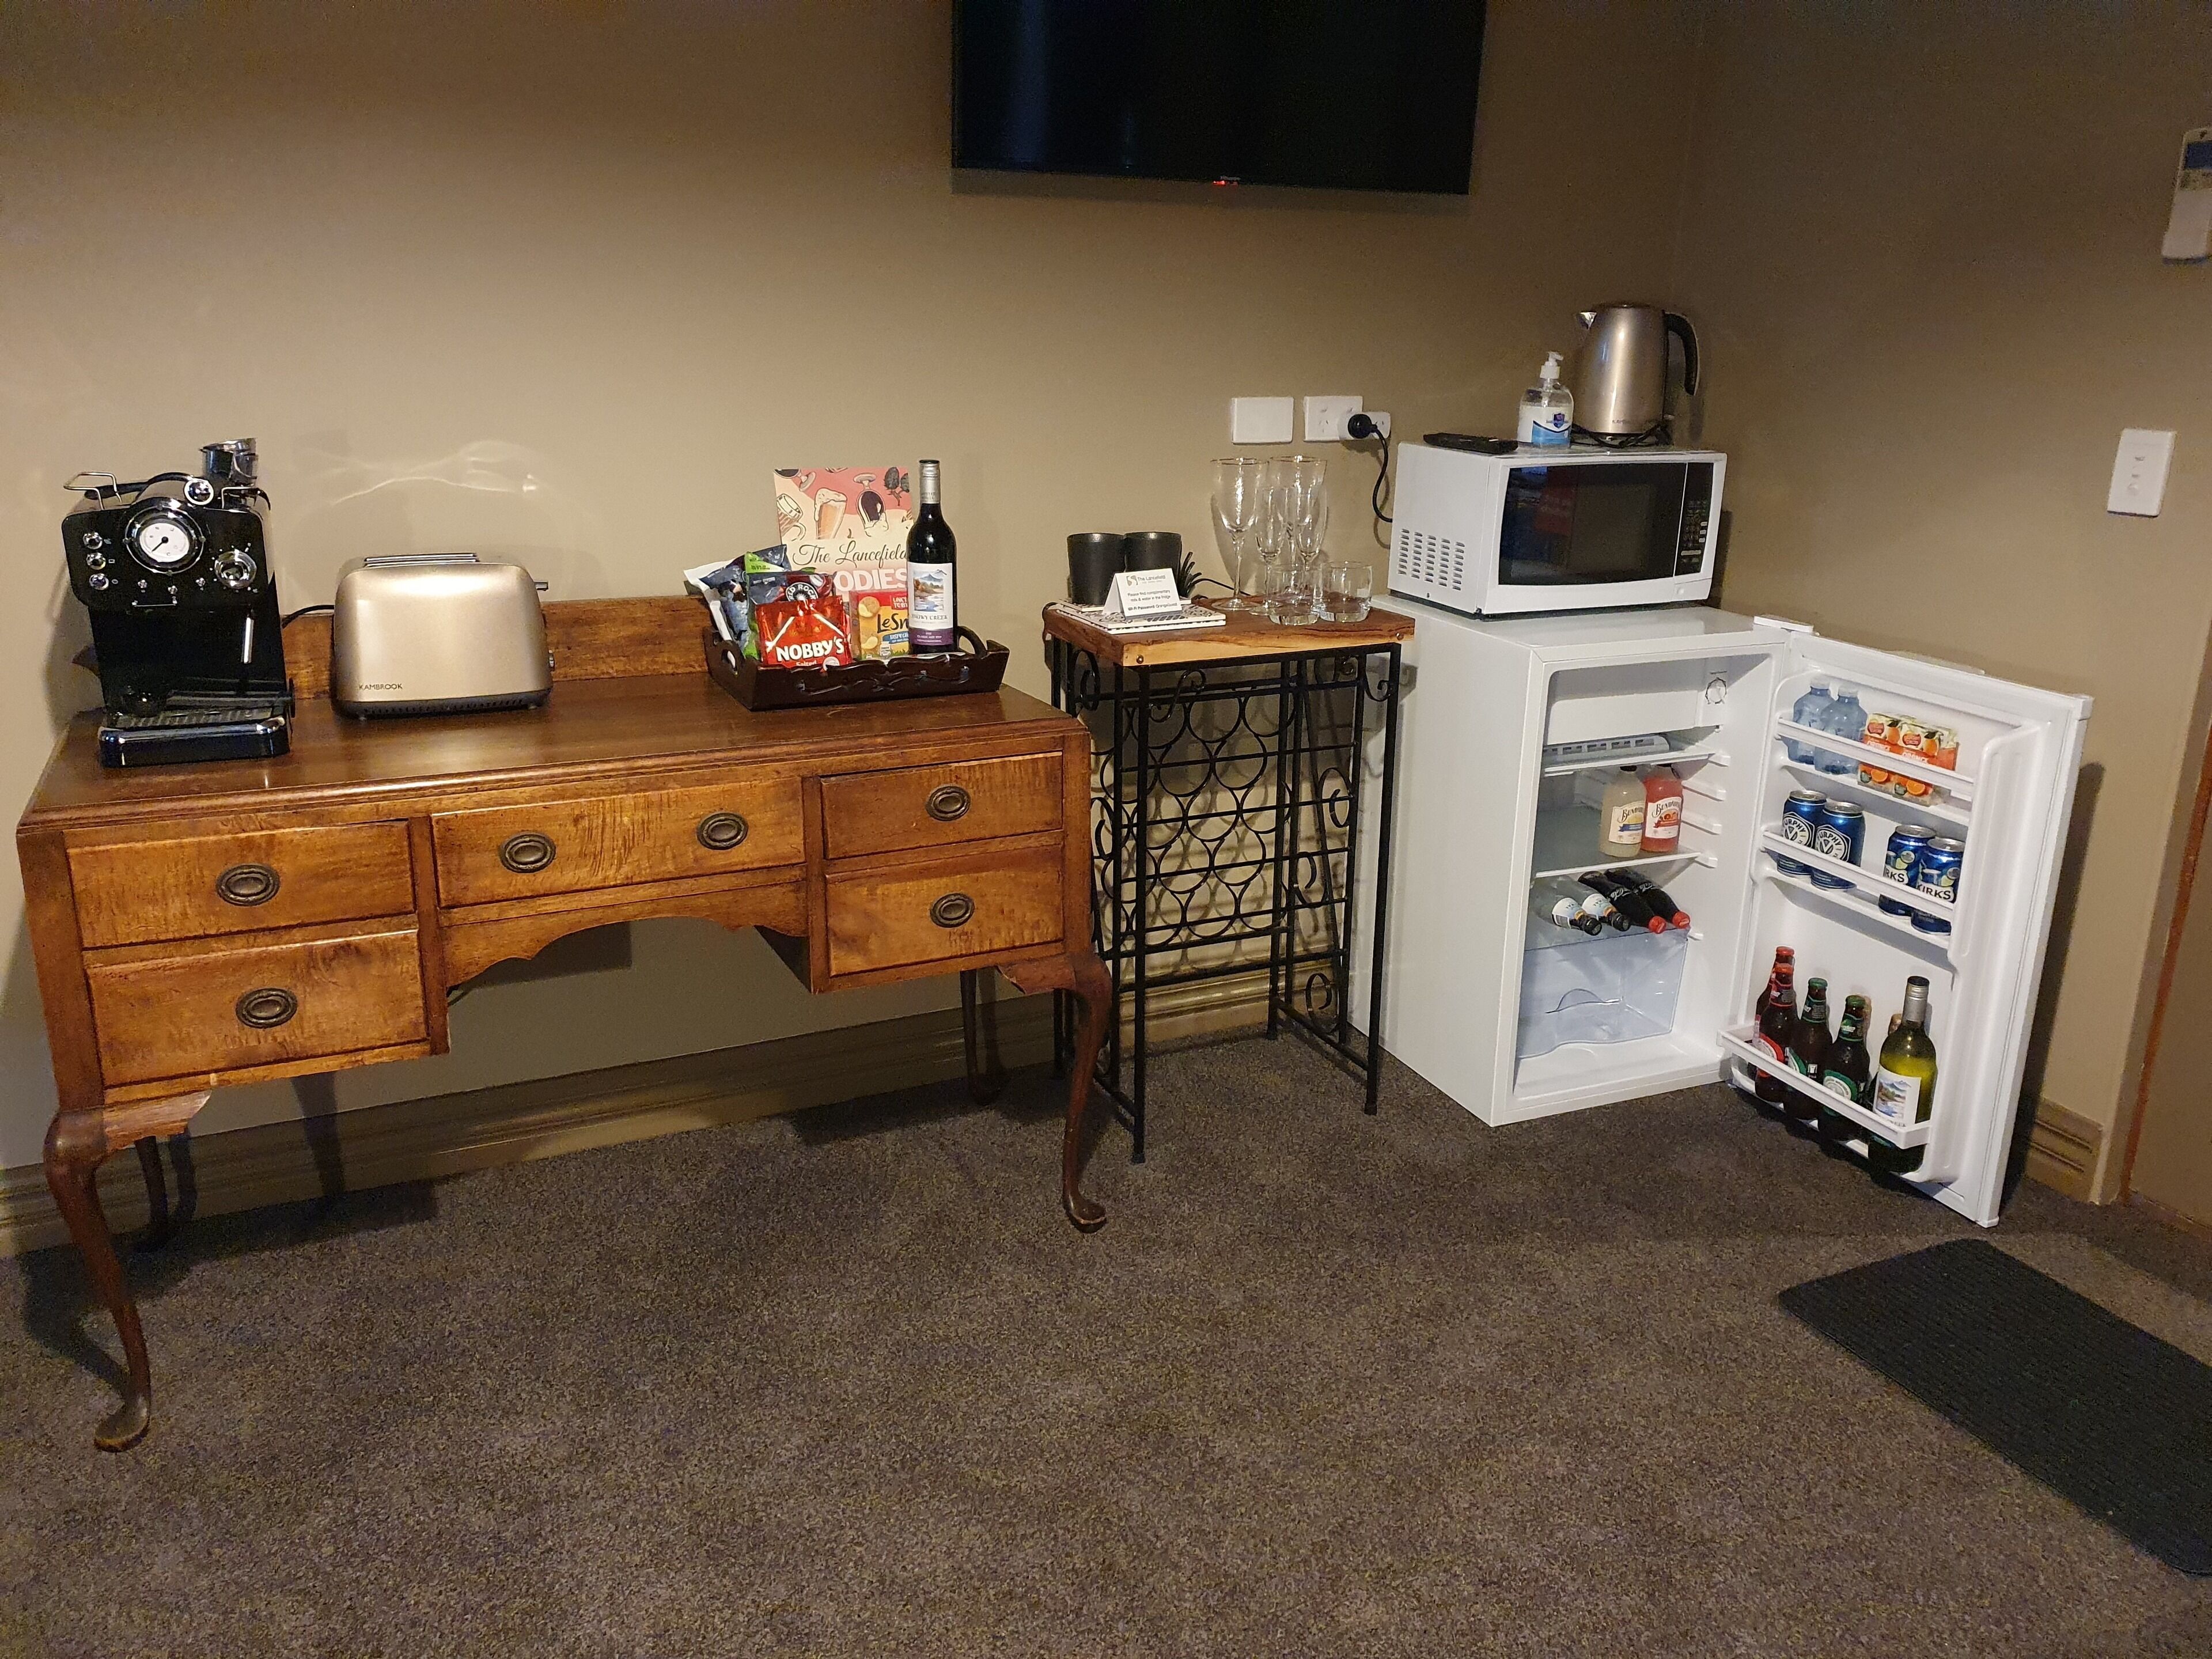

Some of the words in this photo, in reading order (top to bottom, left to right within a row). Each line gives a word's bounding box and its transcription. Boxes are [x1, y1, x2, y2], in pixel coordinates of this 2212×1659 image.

[793, 544, 831, 566] The
[834, 569, 907, 592] ODIES
[877, 613, 908, 634] LeSn
[775, 636, 844, 662] NOBBY'S
[1783, 819, 1806, 833] URPHY
[1818, 830, 1842, 846] URPHY
[1885, 868, 1905, 882] RKS
[1917, 884, 1951, 900] KIRKS
